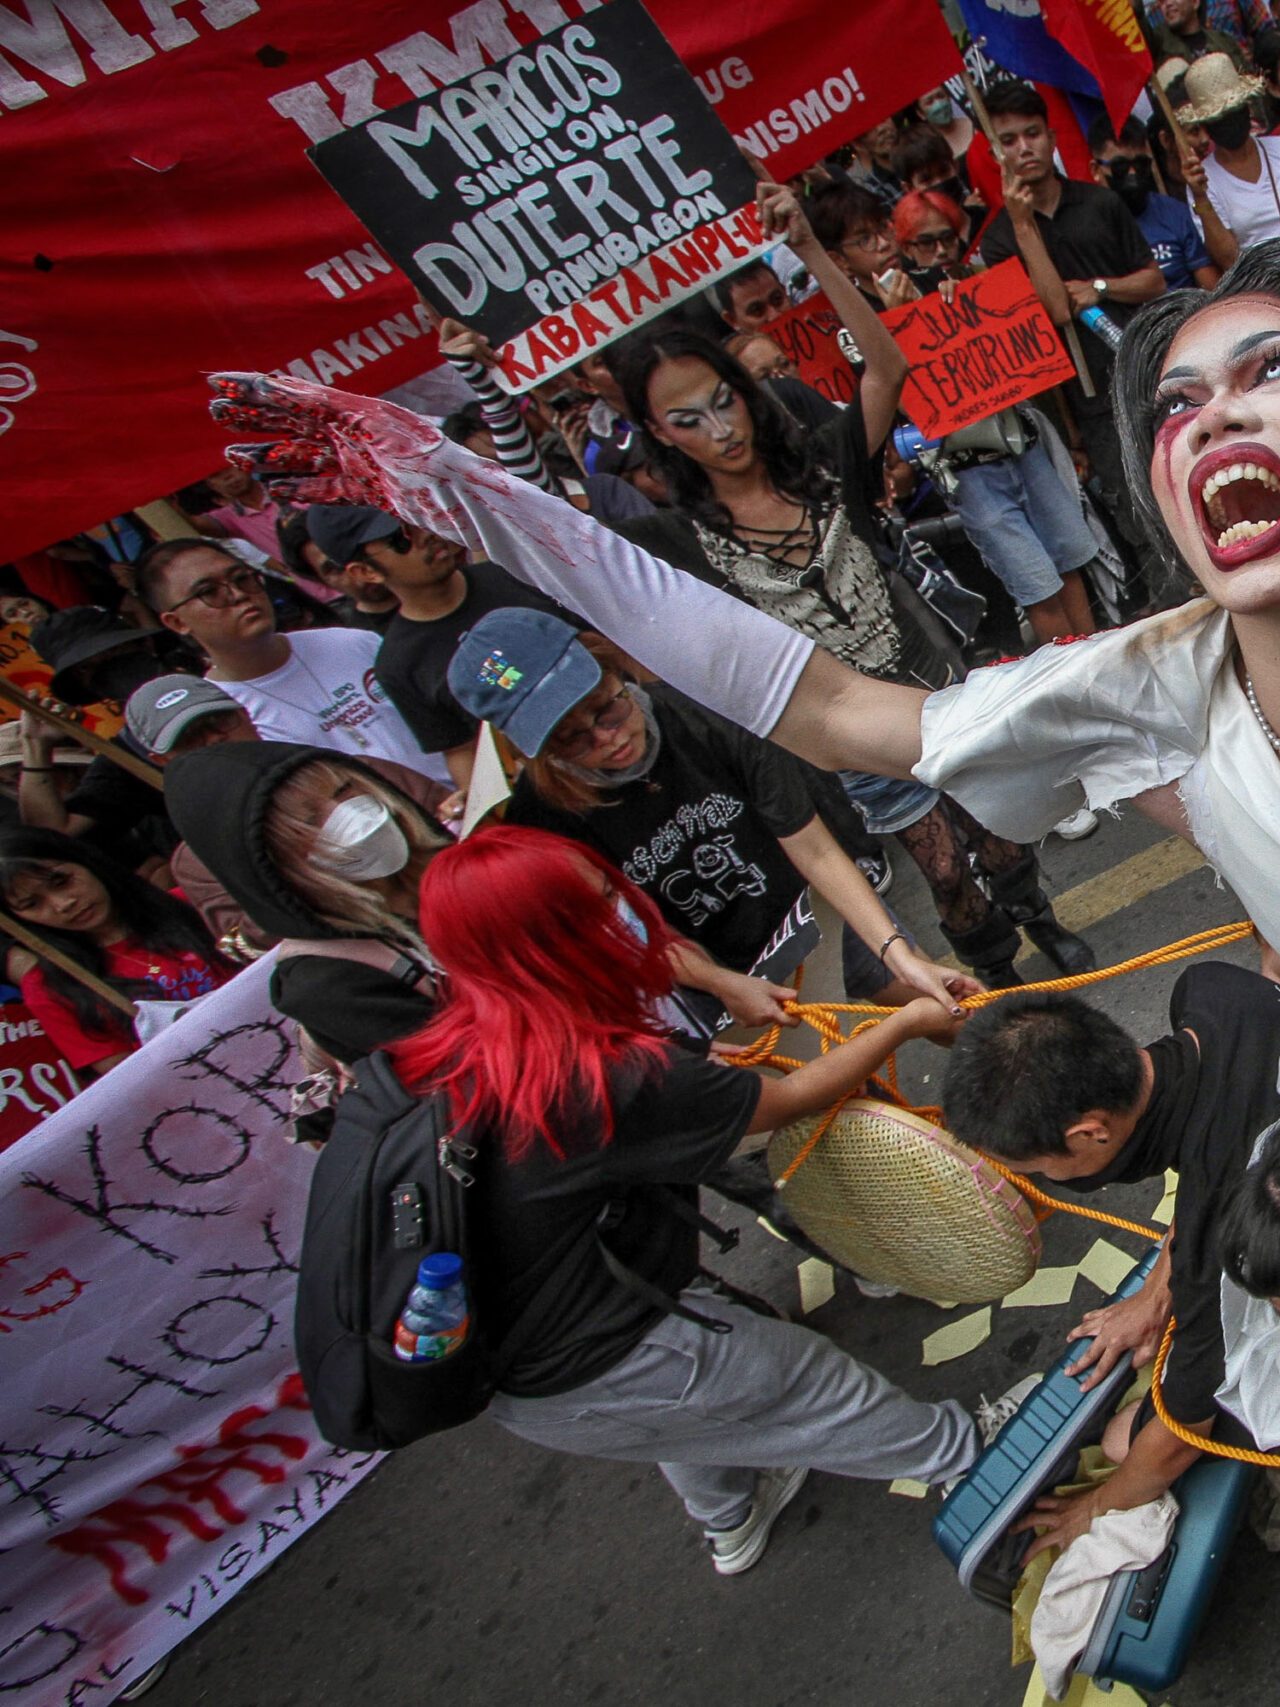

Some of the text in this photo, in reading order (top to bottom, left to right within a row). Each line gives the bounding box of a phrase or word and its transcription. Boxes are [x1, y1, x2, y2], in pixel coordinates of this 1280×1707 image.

[366, 25, 621, 199] MARCOS
[733, 67, 865, 159] NISMO!
[412, 114, 713, 316] DUTERTE
[525, 190, 726, 315] PANUBAGON
[903, 283, 1008, 350] JUNK
[996, 313, 1057, 372] LAWS
